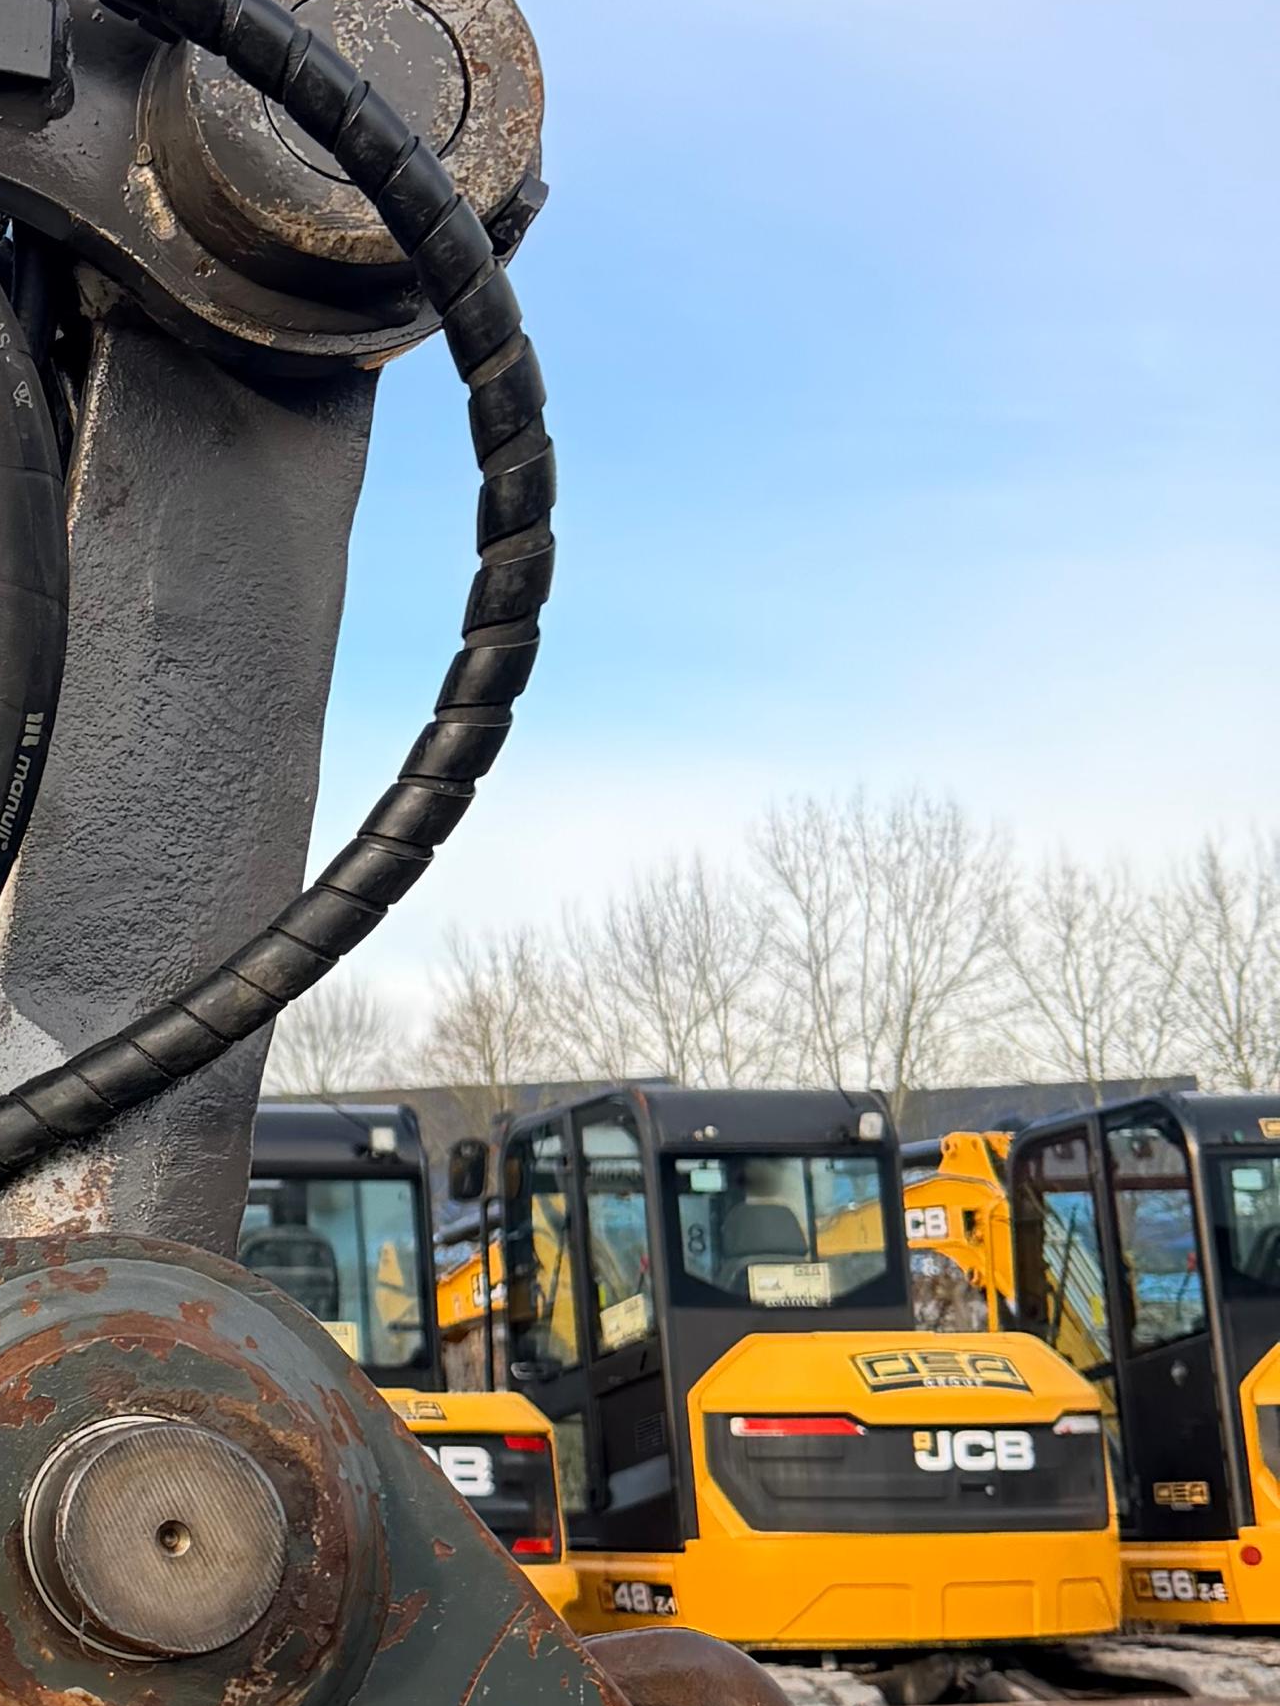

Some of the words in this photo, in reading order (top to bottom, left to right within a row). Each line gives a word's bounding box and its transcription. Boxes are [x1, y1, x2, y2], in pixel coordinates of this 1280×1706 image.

[913, 1430, 1035, 1471] JCB
[614, 1580, 650, 1613] 48
[1151, 1569, 1196, 1601] 56
